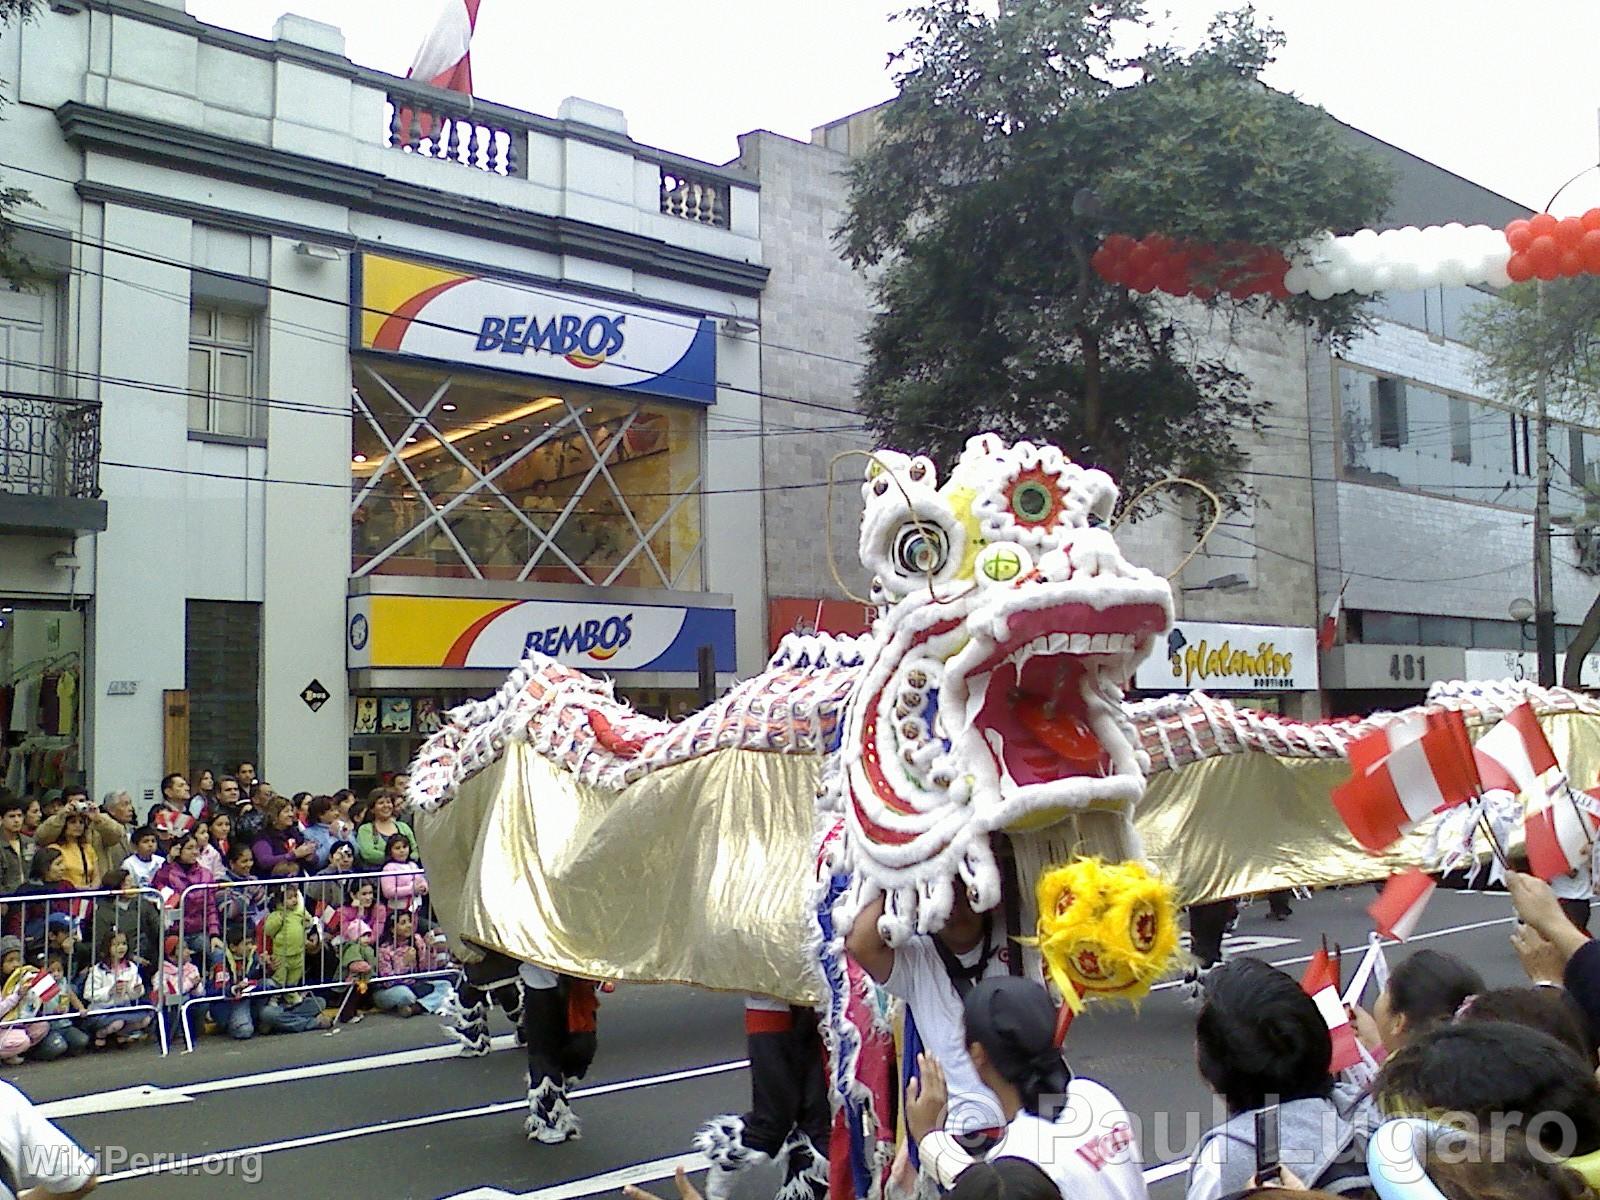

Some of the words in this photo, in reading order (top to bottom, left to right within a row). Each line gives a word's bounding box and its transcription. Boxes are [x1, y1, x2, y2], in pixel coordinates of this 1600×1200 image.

[475, 315, 626, 357] BEMBOS
[520, 613, 633, 660] BEMBOS
[1389, 653, 1426, 681] 481
